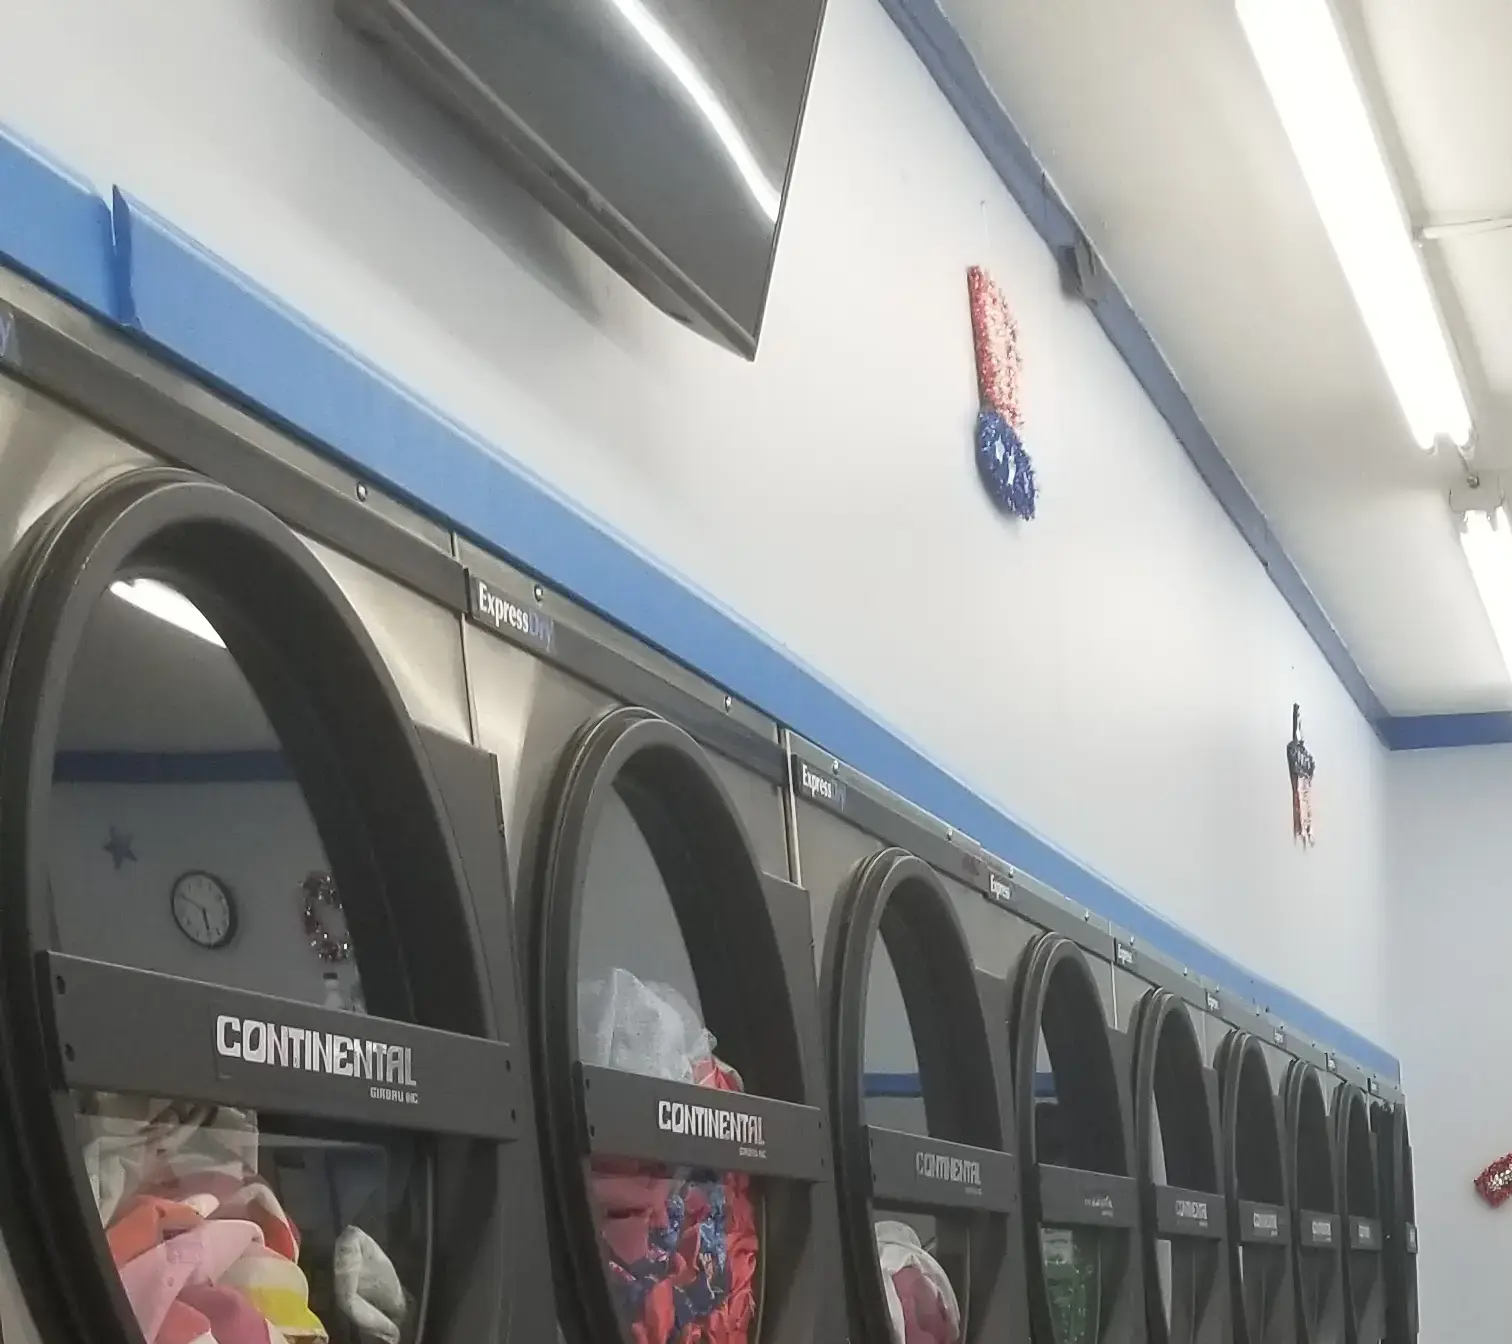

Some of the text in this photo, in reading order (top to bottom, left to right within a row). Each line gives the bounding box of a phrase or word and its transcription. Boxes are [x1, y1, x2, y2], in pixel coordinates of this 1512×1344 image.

[216, 1014, 417, 1087] CONTINENTAL
[658, 1100, 765, 1145] CONTINENTAL
[916, 1152, 982, 1185] CONTINENTAL
